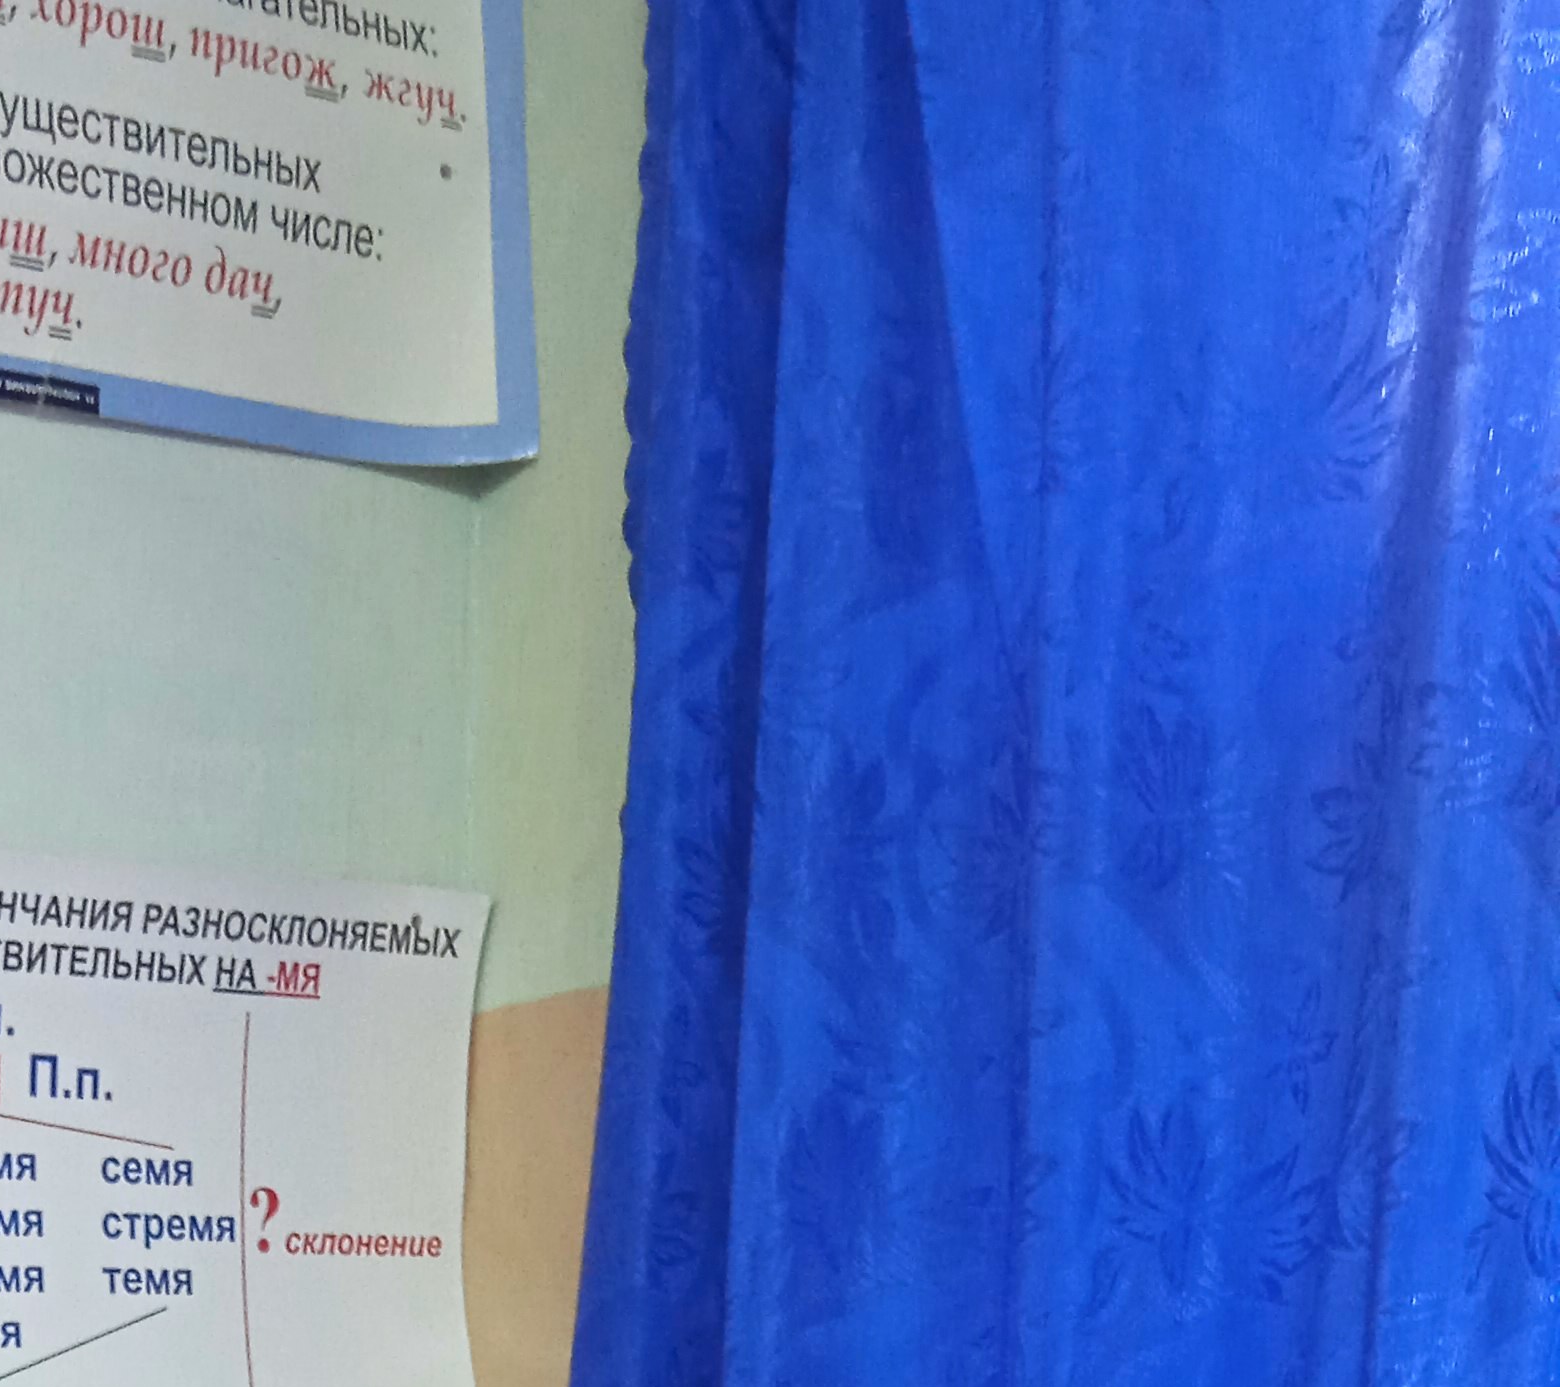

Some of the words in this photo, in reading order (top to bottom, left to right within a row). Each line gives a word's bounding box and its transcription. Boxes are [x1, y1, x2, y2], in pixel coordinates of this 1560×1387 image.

[190, 26, 350, 102] пригож,
[364, 66, 467, 130] жгуч.
[270, 207, 384, 261] числе:
[68, 231, 191, 288] много
[204, 245, 282, 319] дач,
[142, 902, 462, 959] РАЗНОСКЛОНЯЕМЫХ
[213, 956, 258, 993] НА
[267, 960, 321, 999] -МЯ
[29, 1053, 113, 1101] П.п.
[101, 1155, 194, 1187] семя
[101, 1211, 236, 1248] стремя
[249, 1186, 280, 1254] ?
[285, 1230, 443, 1259] склонение
[101, 1266, 194, 1296] темя
